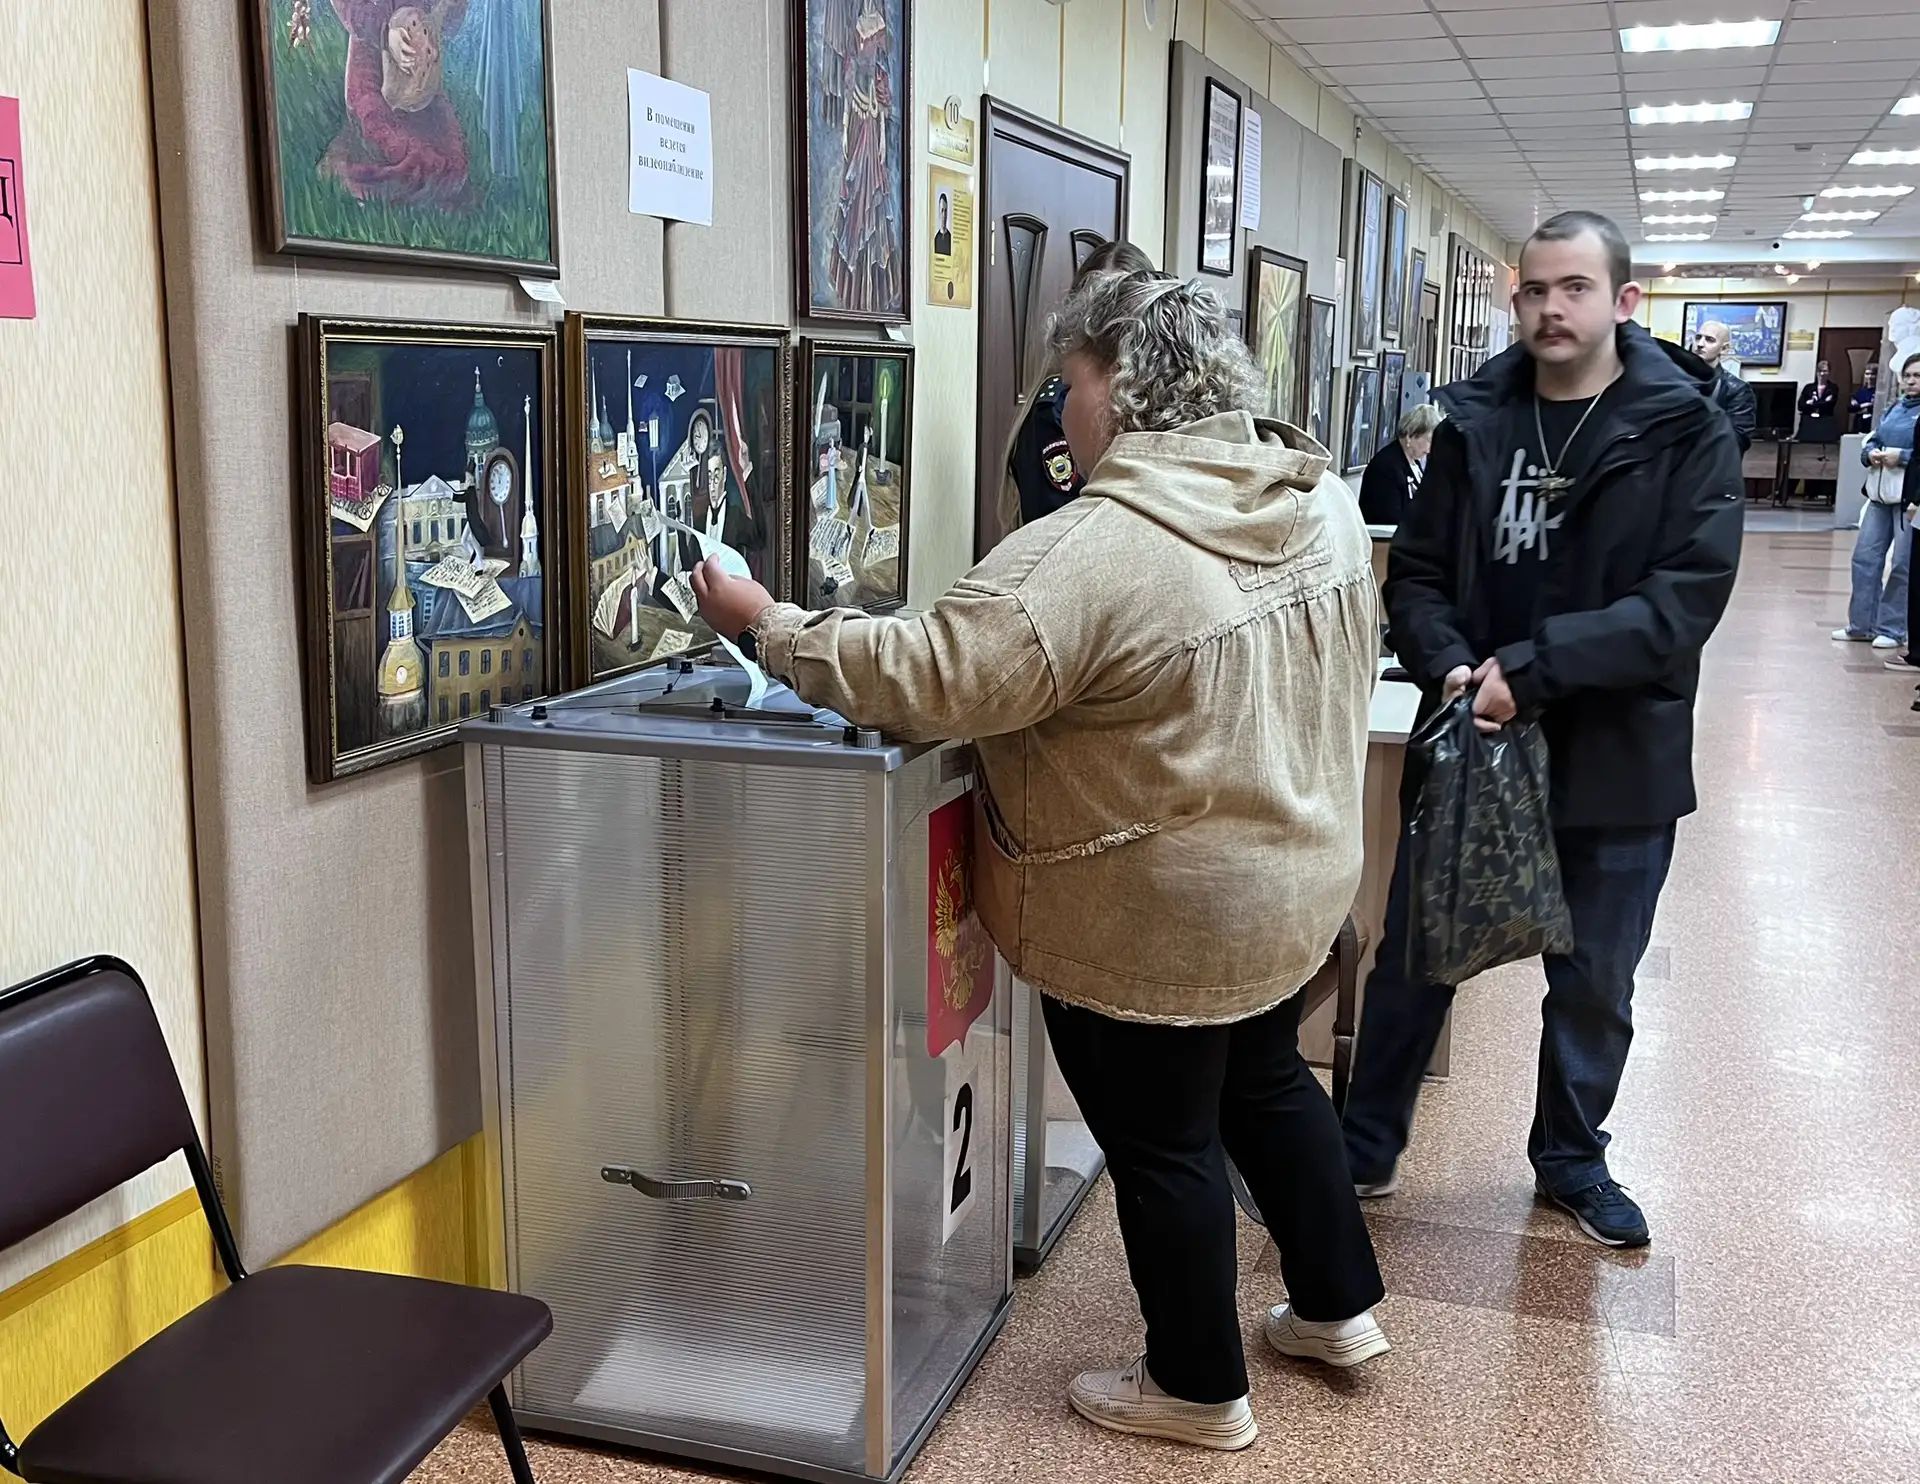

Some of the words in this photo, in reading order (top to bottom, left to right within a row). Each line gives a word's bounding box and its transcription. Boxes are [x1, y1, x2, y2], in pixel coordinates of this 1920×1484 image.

[646, 106, 653, 122] В
[949, 102, 959, 124] 10
[950, 1082, 973, 1215] 2
